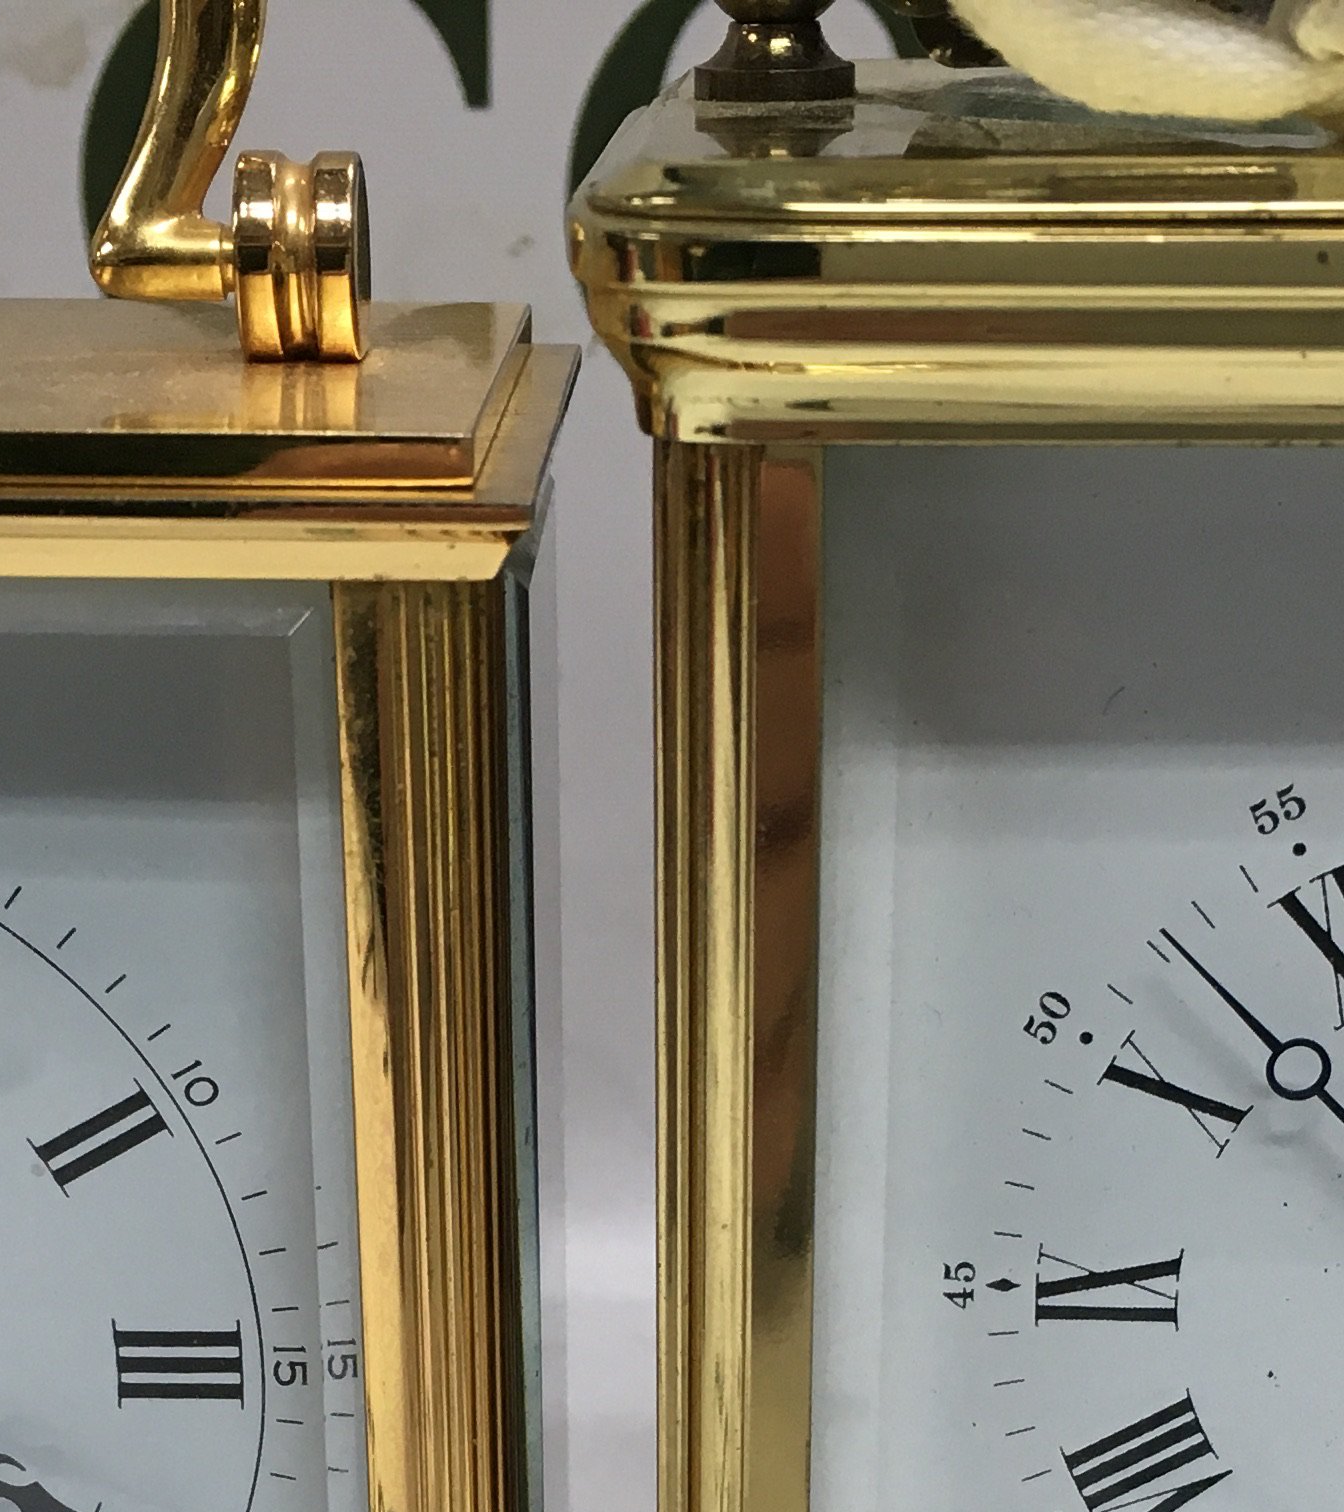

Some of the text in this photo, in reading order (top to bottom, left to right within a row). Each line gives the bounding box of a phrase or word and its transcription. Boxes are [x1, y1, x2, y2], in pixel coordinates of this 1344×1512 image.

[1249, 784, 1306, 835] 55
[1023, 991, 1071, 1045] 50
[171, 1060, 219, 1107] 10
[1096, 1030, 1254, 1158] X
[26, 1078, 174, 1197] II
[942, 1261, 976, 1310] 45
[1035, 1243, 1184, 1332] IX
[111, 1319, 244, 1409] III
[272, 1345, 308, 1386] 15
[327, 1338, 358, 1380] 15
